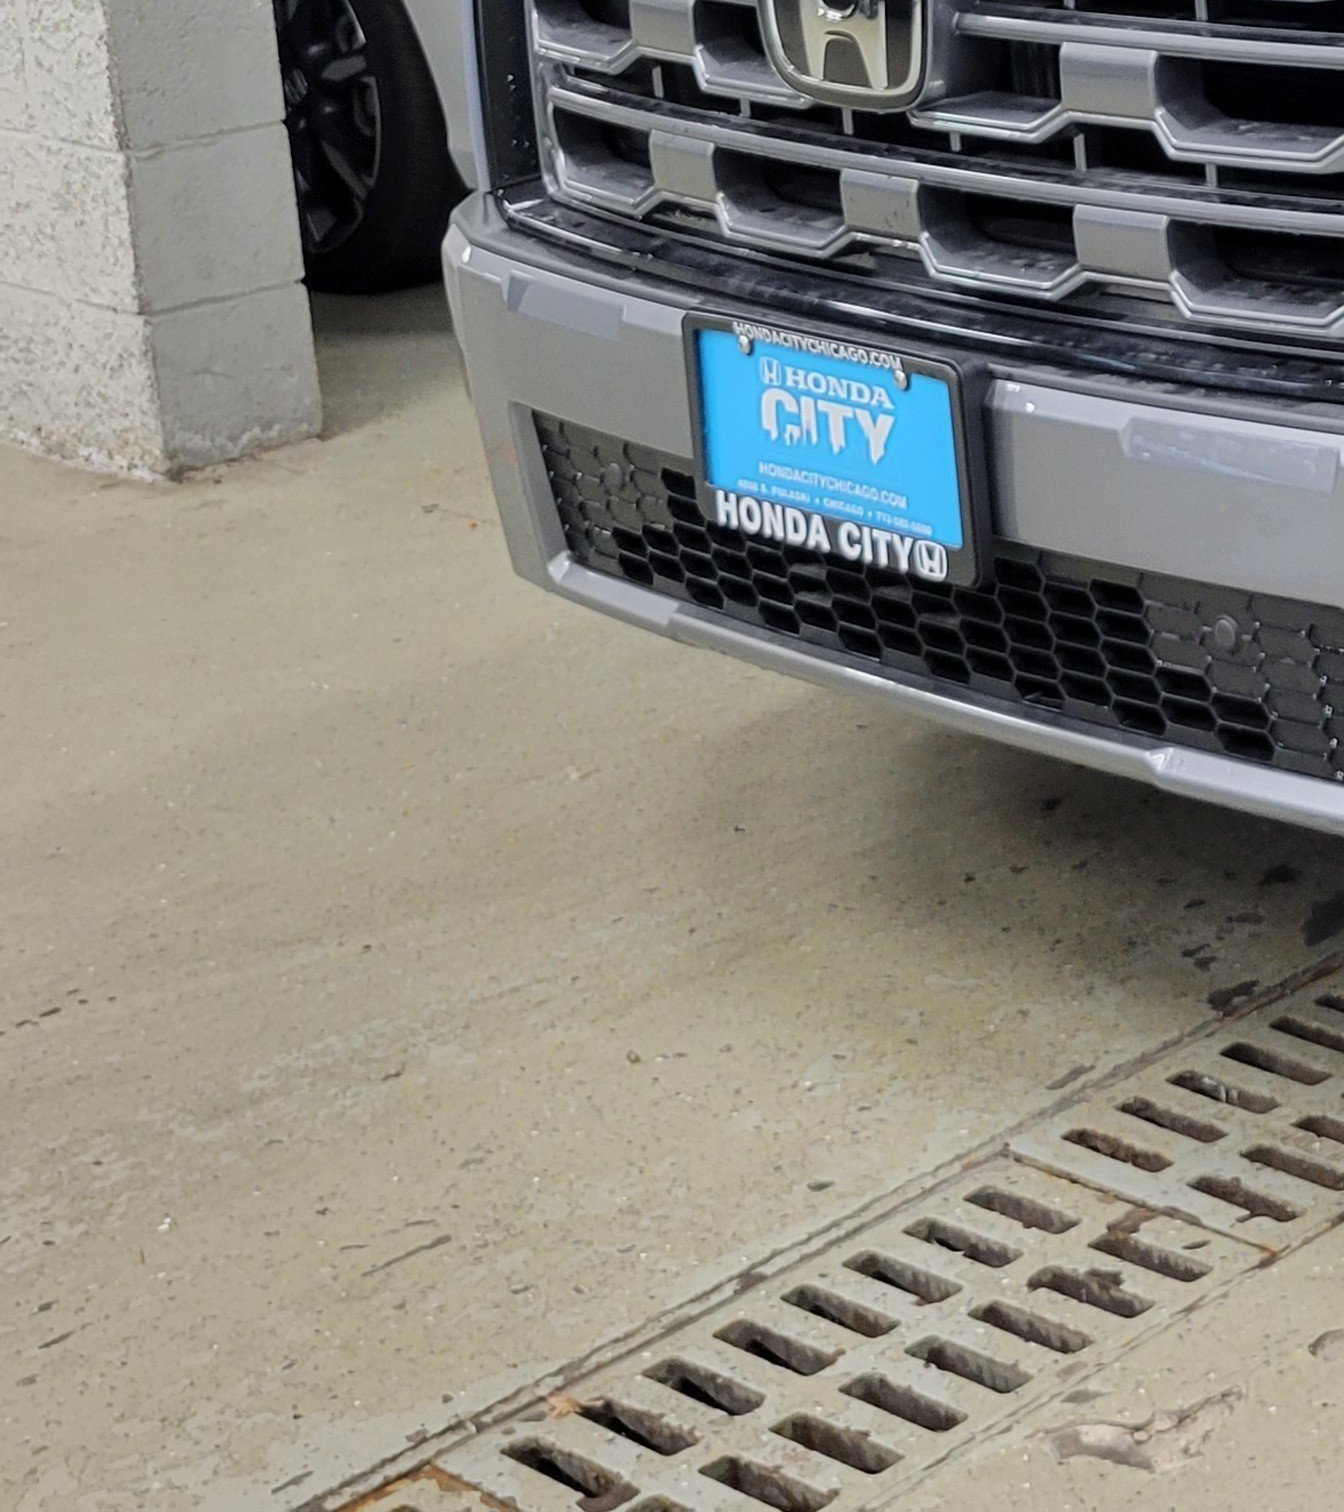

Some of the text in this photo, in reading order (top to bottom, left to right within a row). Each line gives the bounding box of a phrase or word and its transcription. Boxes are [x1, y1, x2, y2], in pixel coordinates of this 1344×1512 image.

[732, 321, 903, 371] HONDACITYCHICAGO.COM
[784, 366, 895, 410] HONDA
[760, 388, 895, 466] CITY
[758, 461, 908, 509] HONDACITYCHICAGO.COM
[715, 490, 831, 554] HONDA
[838, 522, 915, 574] CITY
